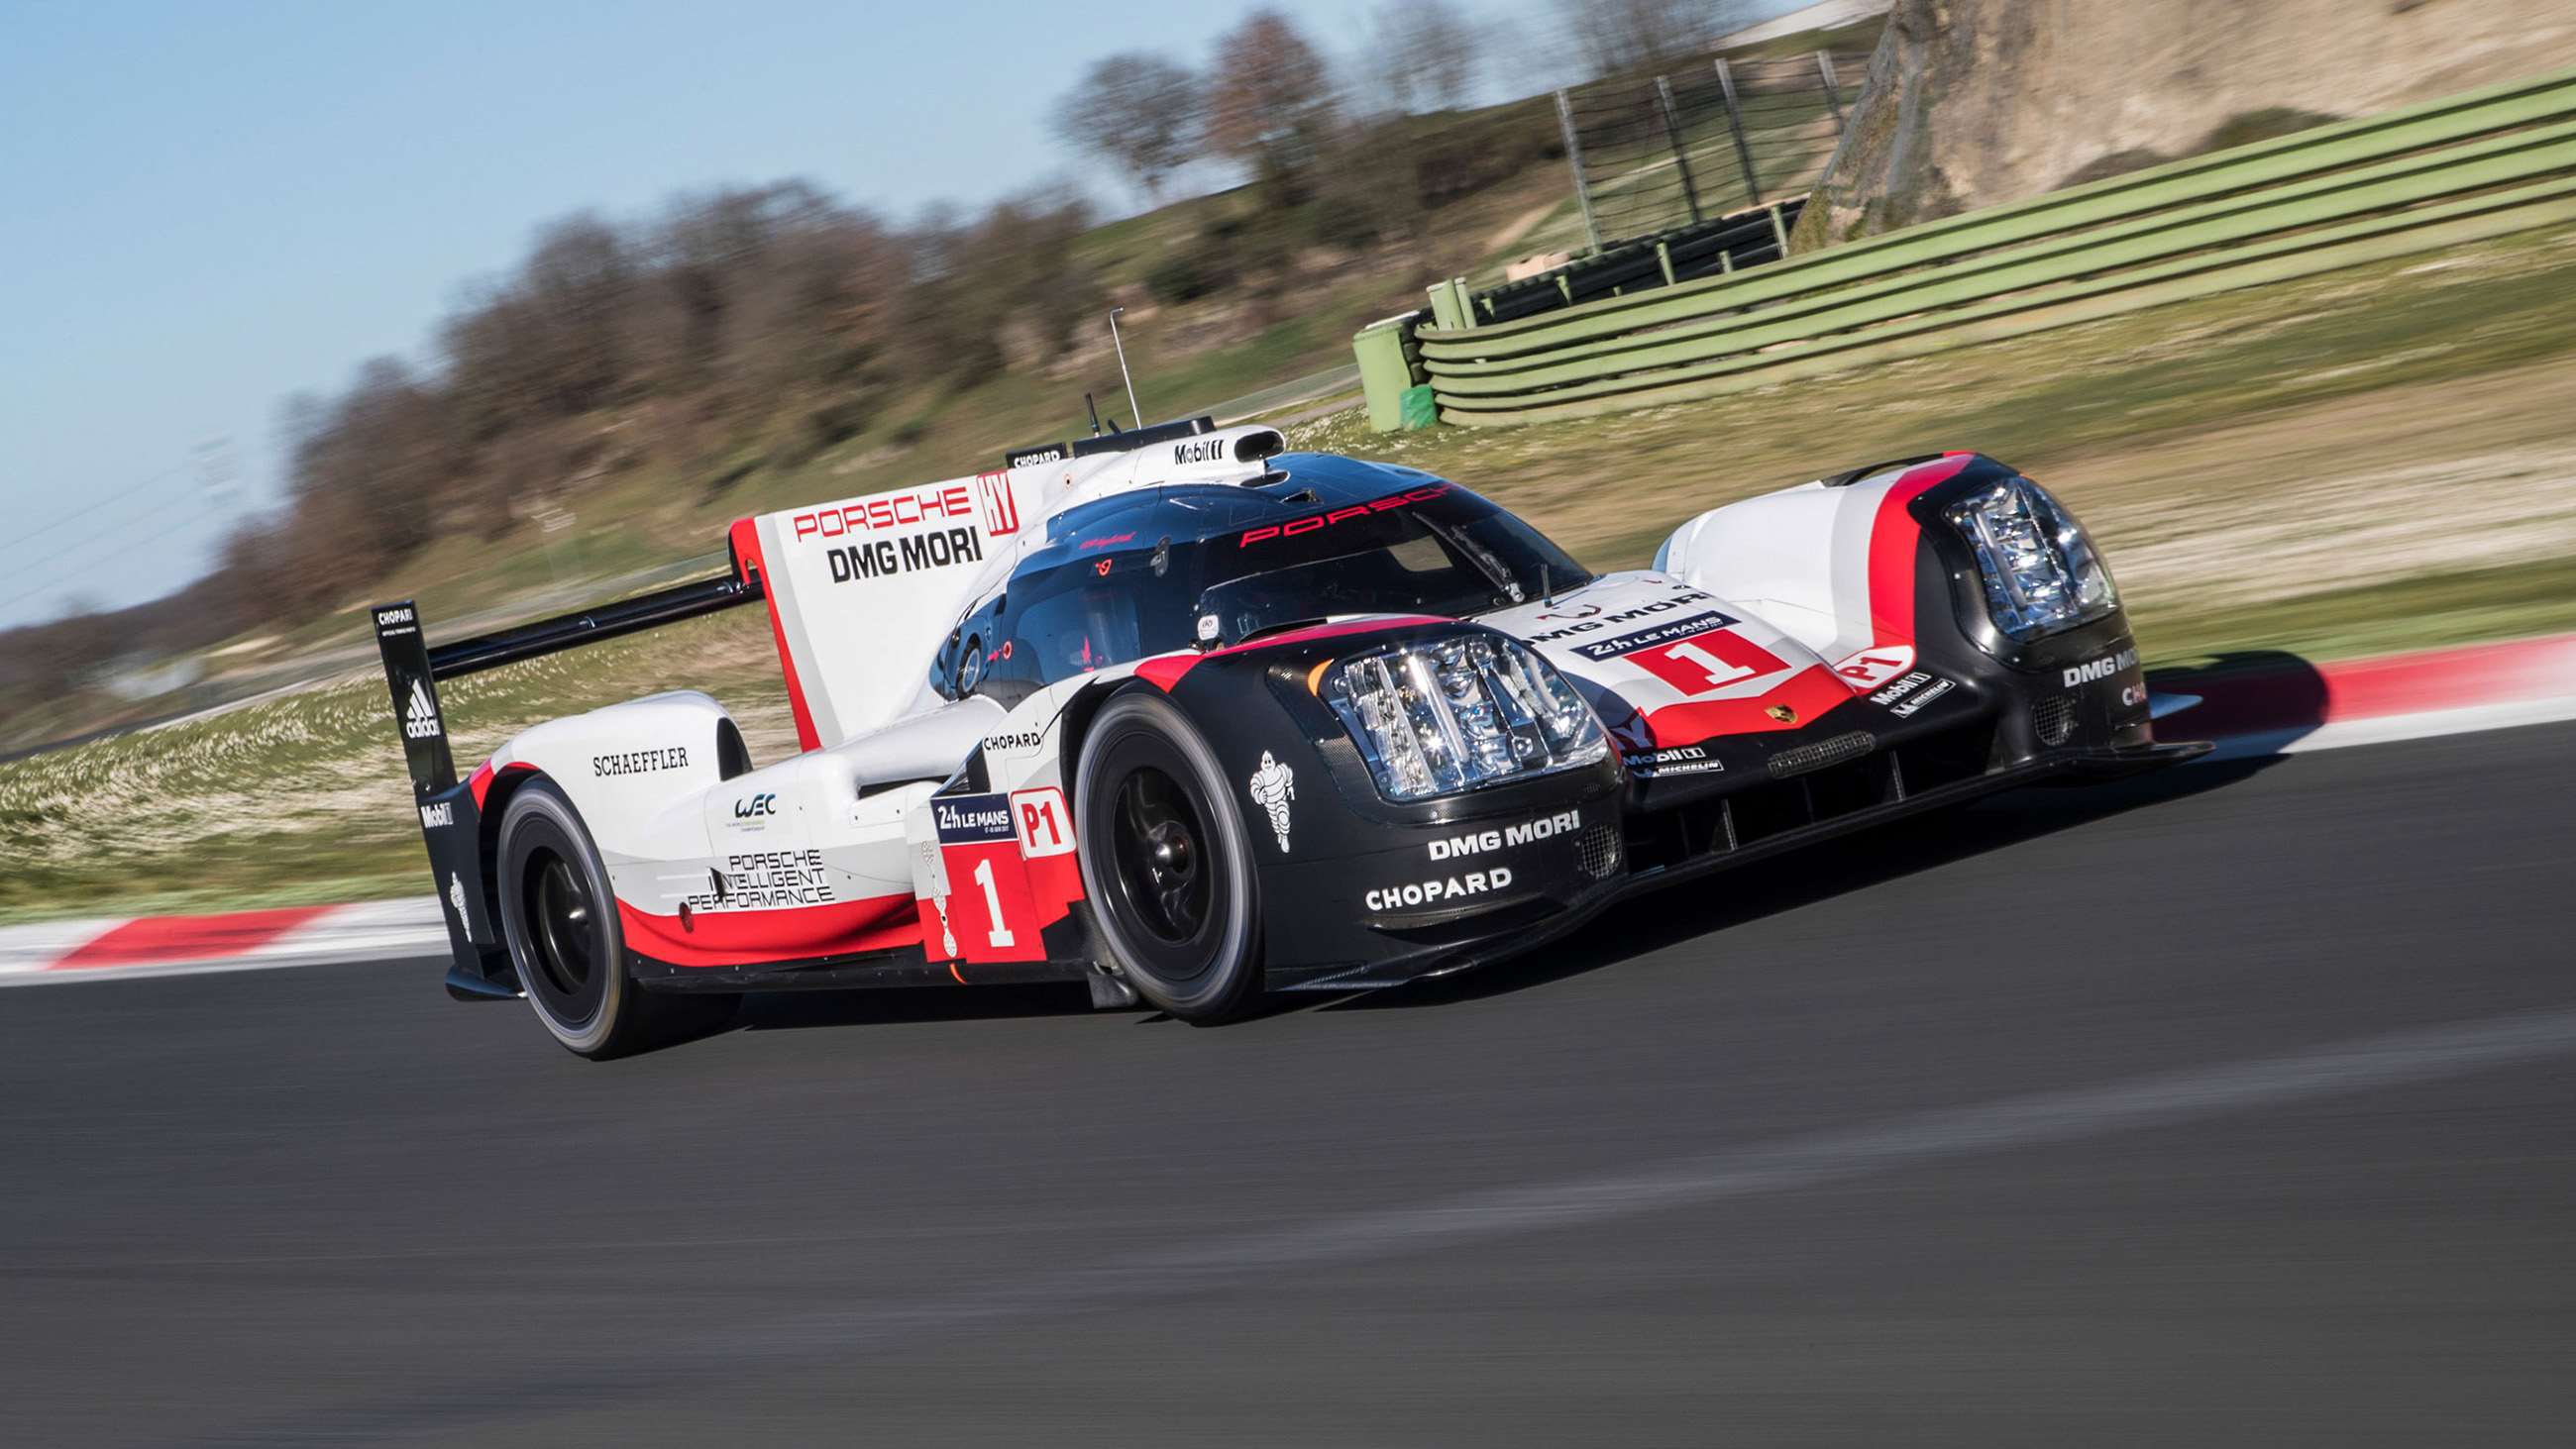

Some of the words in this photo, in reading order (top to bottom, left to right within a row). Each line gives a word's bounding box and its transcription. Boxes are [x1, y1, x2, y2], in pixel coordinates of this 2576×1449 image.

[1014, 451, 1060, 468] CHOPARD
[1174, 441, 1210, 466] Mobil
[794, 486, 972, 543] PORSCHE
[1240, 483, 1453, 549] PORSCH
[827, 540, 898, 583] DMG
[900, 526, 983, 571] MORI
[1634, 633, 1662, 644] LE
[1663, 616, 1722, 637] MANS
[1664, 643, 1757, 684] 1
[1840, 657, 1903, 681] P1
[2063, 657, 2116, 687] DMG
[2116, 648, 2138, 672] MO
[1870, 676, 1919, 705] Mobil
[984, 732, 1040, 751] CHOPARD
[592, 747, 689, 776] SCHAEFFLER
[1623, 749, 1683, 767] Mobil
[1659, 761, 1719, 775] MICHELIN
[735, 793, 776, 818] WEC
[961, 813, 976, 828] LE
[976, 809, 1010, 828] MANS
[1021, 800, 1061, 848] P1
[1428, 832, 1501, 861] DMG
[1505, 809, 1580, 847] MORI
[729, 849, 822, 872] PORSCHE
[688, 885, 835, 910] PERFORMANCE
[974, 859, 1015, 947] 1
[1365, 868, 1512, 911] CHOPARD
